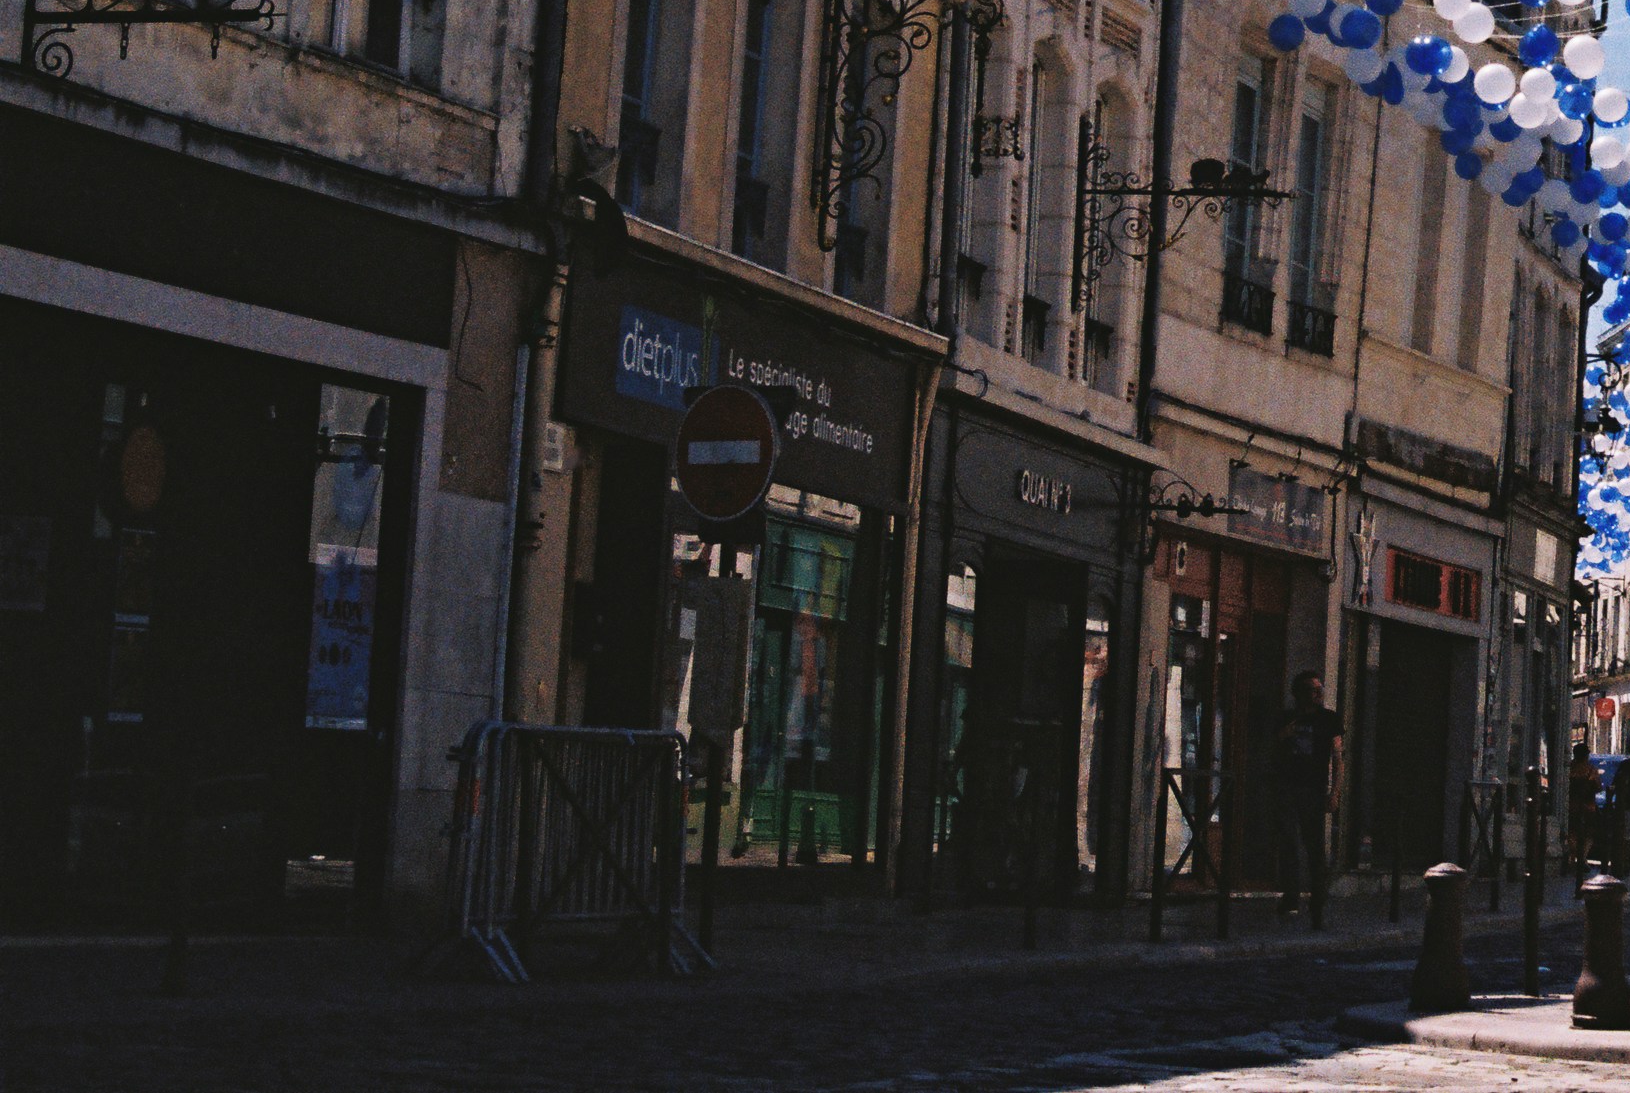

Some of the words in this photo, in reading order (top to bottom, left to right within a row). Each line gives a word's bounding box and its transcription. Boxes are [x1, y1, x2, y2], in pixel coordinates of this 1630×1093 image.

[622, 318, 698, 394] dietplus
[728, 349, 745, 379] Le
[816, 377, 833, 407] du
[812, 414, 874, 453] alimentaire
[1021, 469, 1048, 508] QUAI
